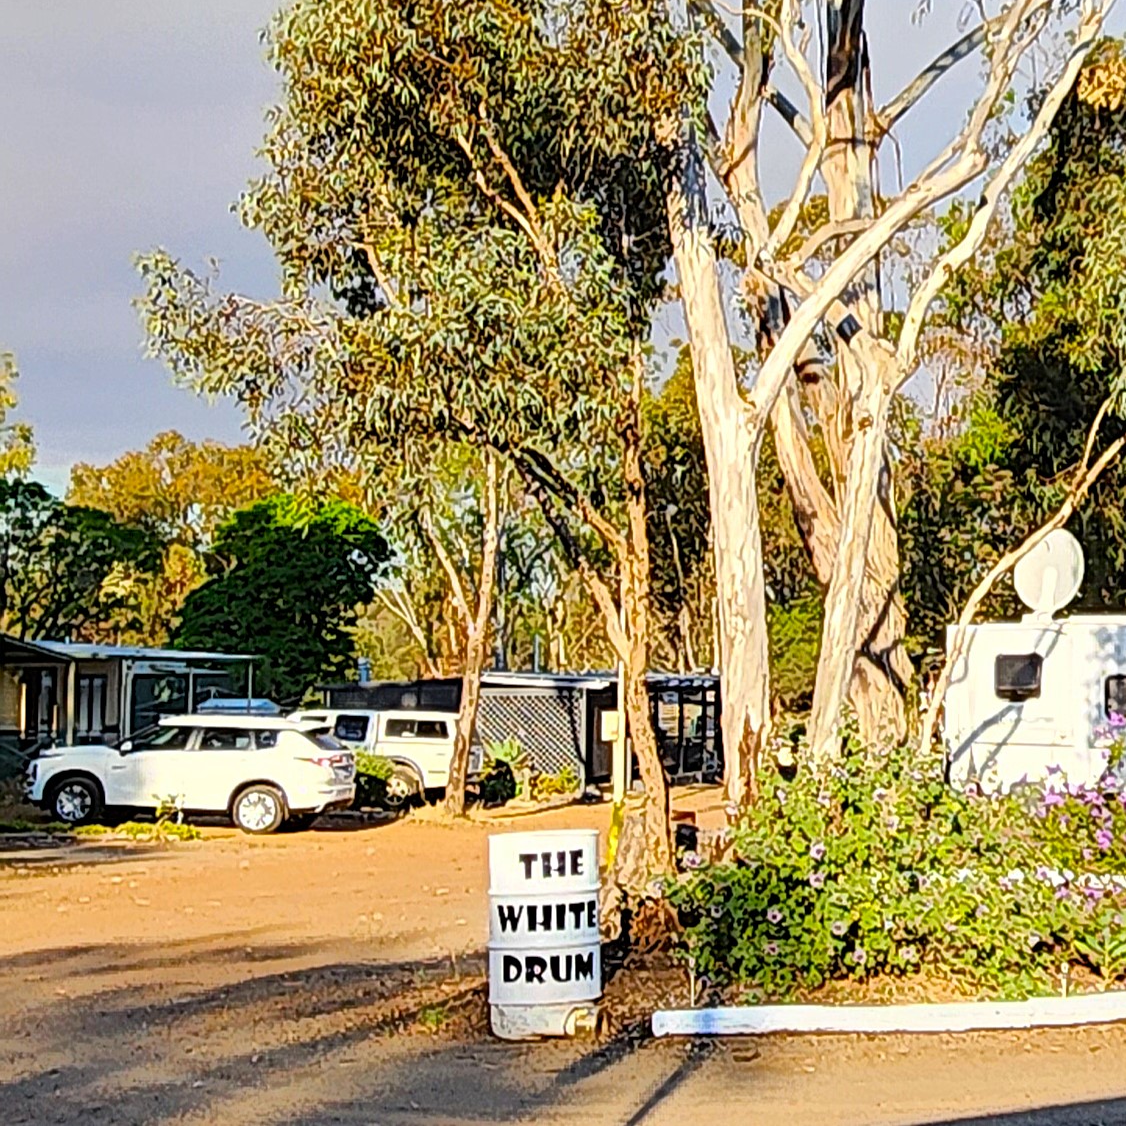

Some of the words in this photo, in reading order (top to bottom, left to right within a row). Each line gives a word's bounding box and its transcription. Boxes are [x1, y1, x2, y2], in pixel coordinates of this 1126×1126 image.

[519, 849, 584, 879] THE
[497, 900, 597, 933] WHITE
[503, 951, 594, 984] DRUM
